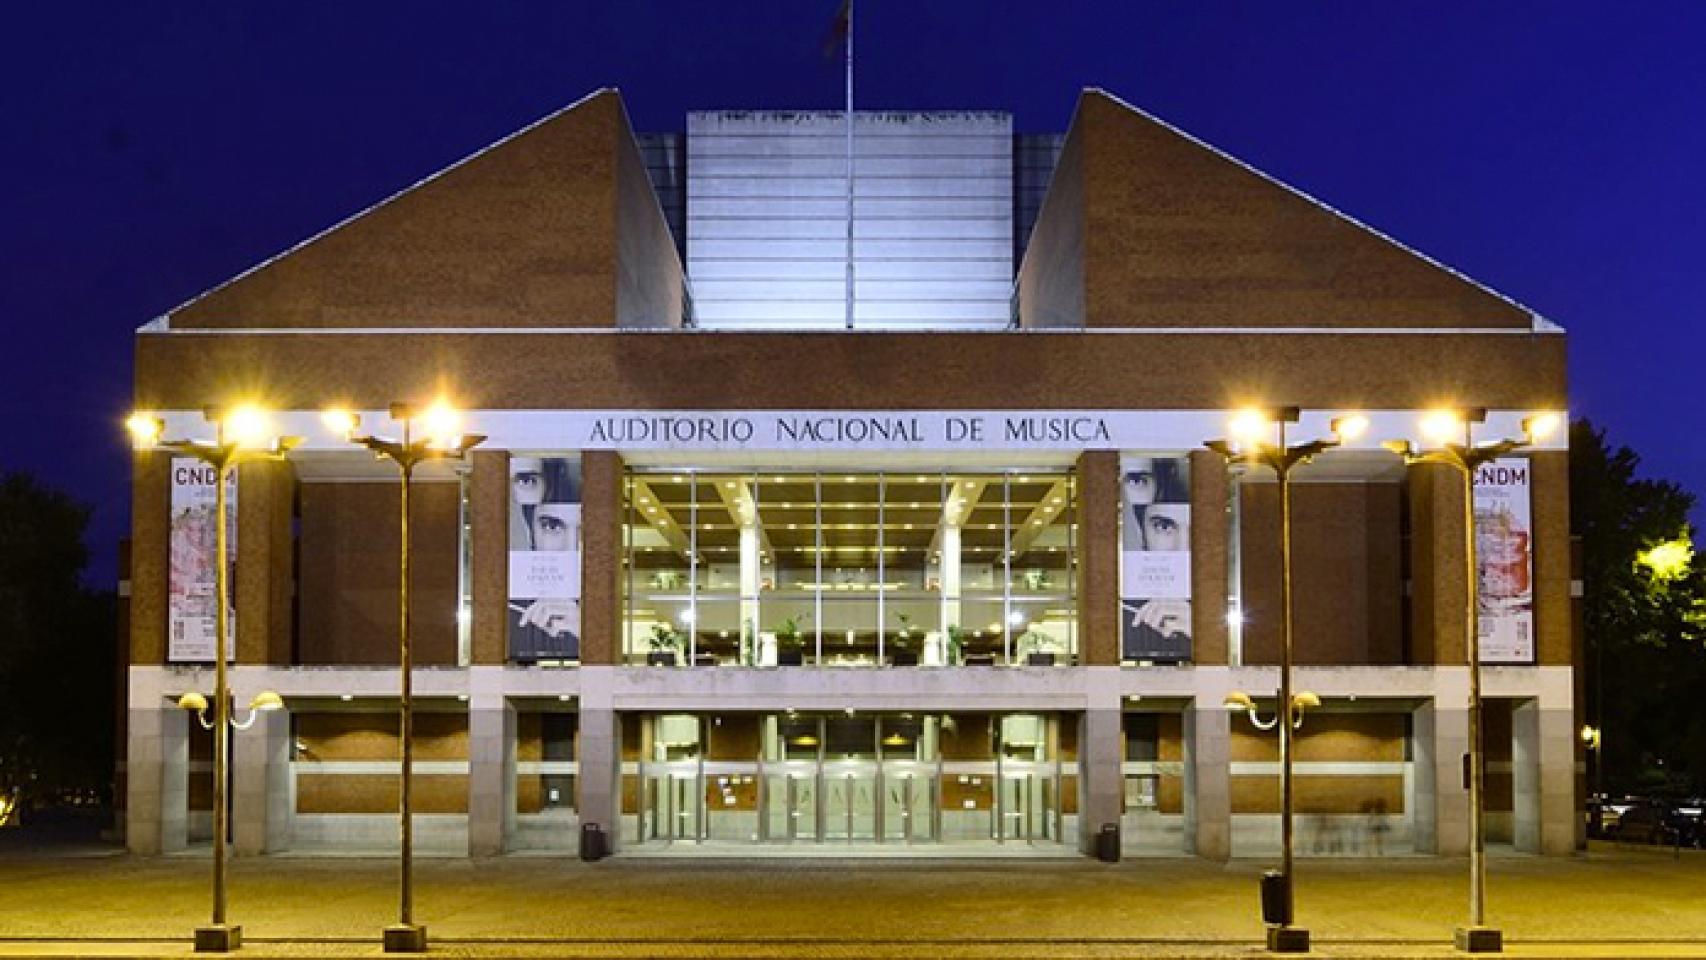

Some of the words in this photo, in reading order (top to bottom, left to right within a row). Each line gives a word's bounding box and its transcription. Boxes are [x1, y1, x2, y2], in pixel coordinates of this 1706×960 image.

[590, 418, 754, 441] AUDITORIO
[776, 418, 924, 442] NACIONAL
[945, 418, 985, 441] DE
[1004, 418, 1111, 441] MUSICA
